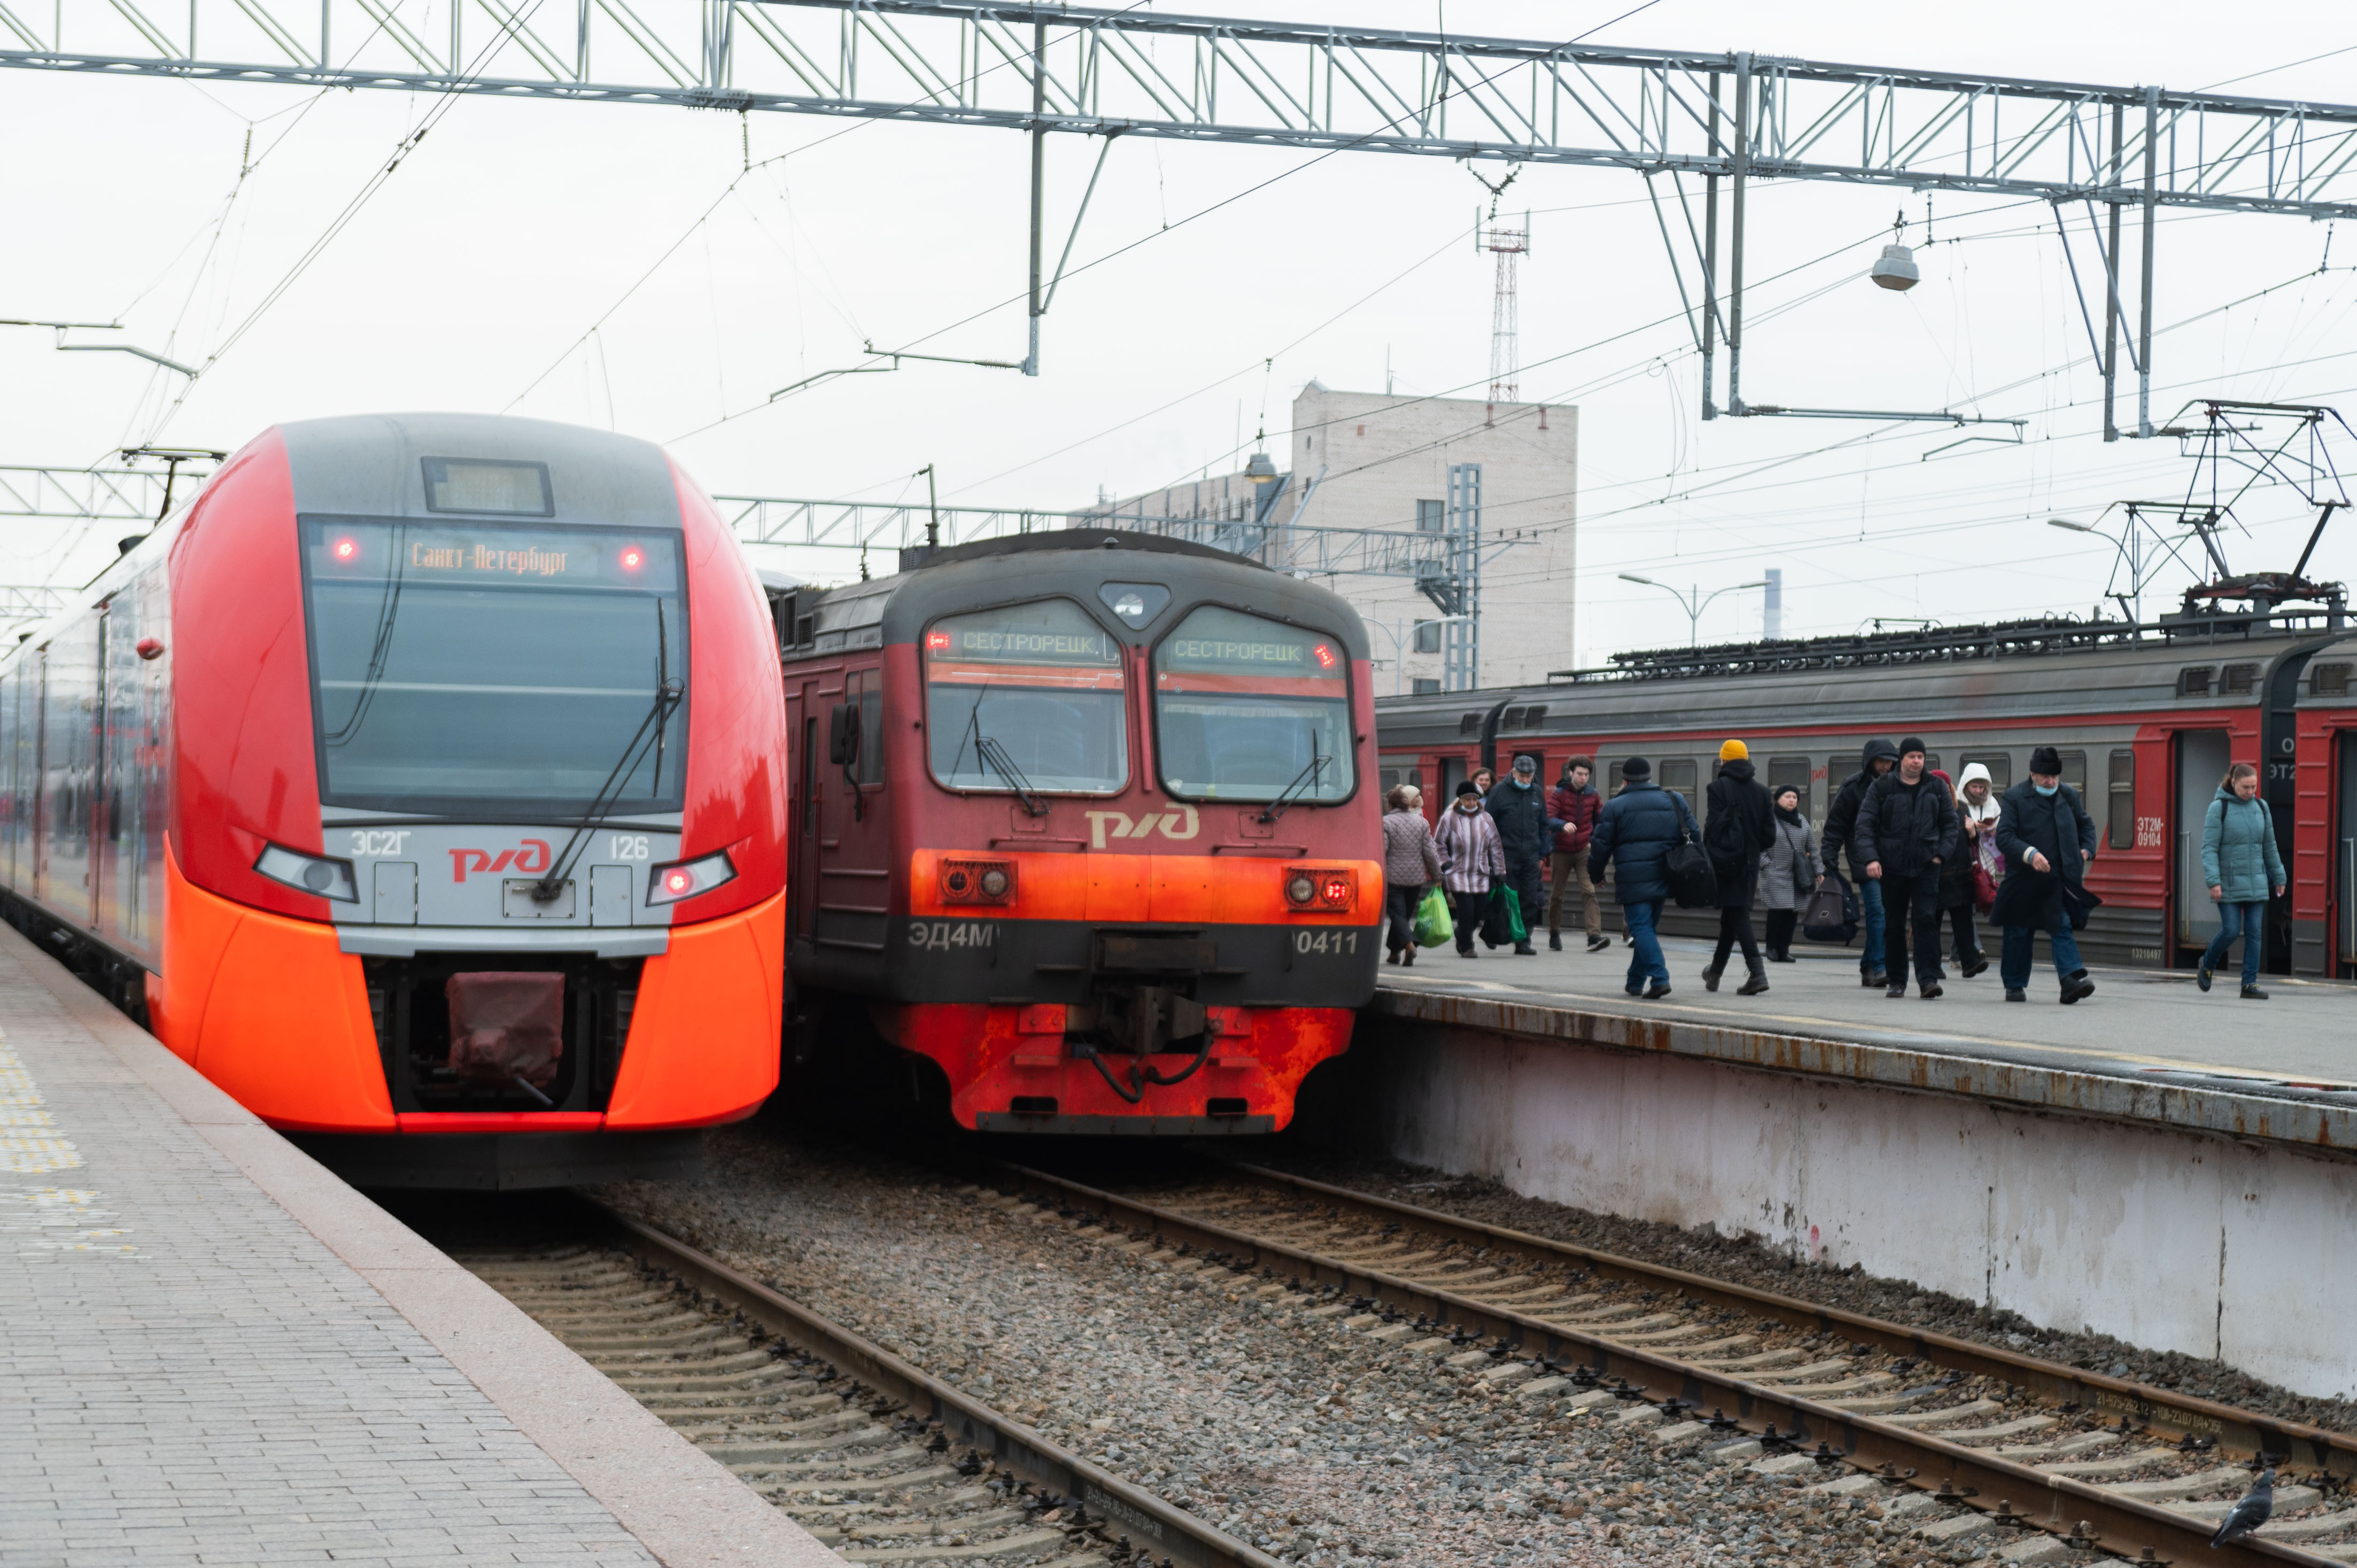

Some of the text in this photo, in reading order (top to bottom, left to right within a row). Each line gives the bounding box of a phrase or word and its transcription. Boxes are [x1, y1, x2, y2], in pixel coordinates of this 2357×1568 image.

[412, 542, 568, 576] Санкт-Петербург
[964, 632, 1094, 653] СЕСТРОРЕЦК
[1176, 640, 1300, 661] СЕСТРОРЕЦК
[351, 830, 412, 855] ЭС2Г
[612, 835, 649, 860] 126
[2138, 832, 2161, 847] 09104
[909, 922, 993, 951] ЭД4М
[1297, 930, 1358, 954] 0411
